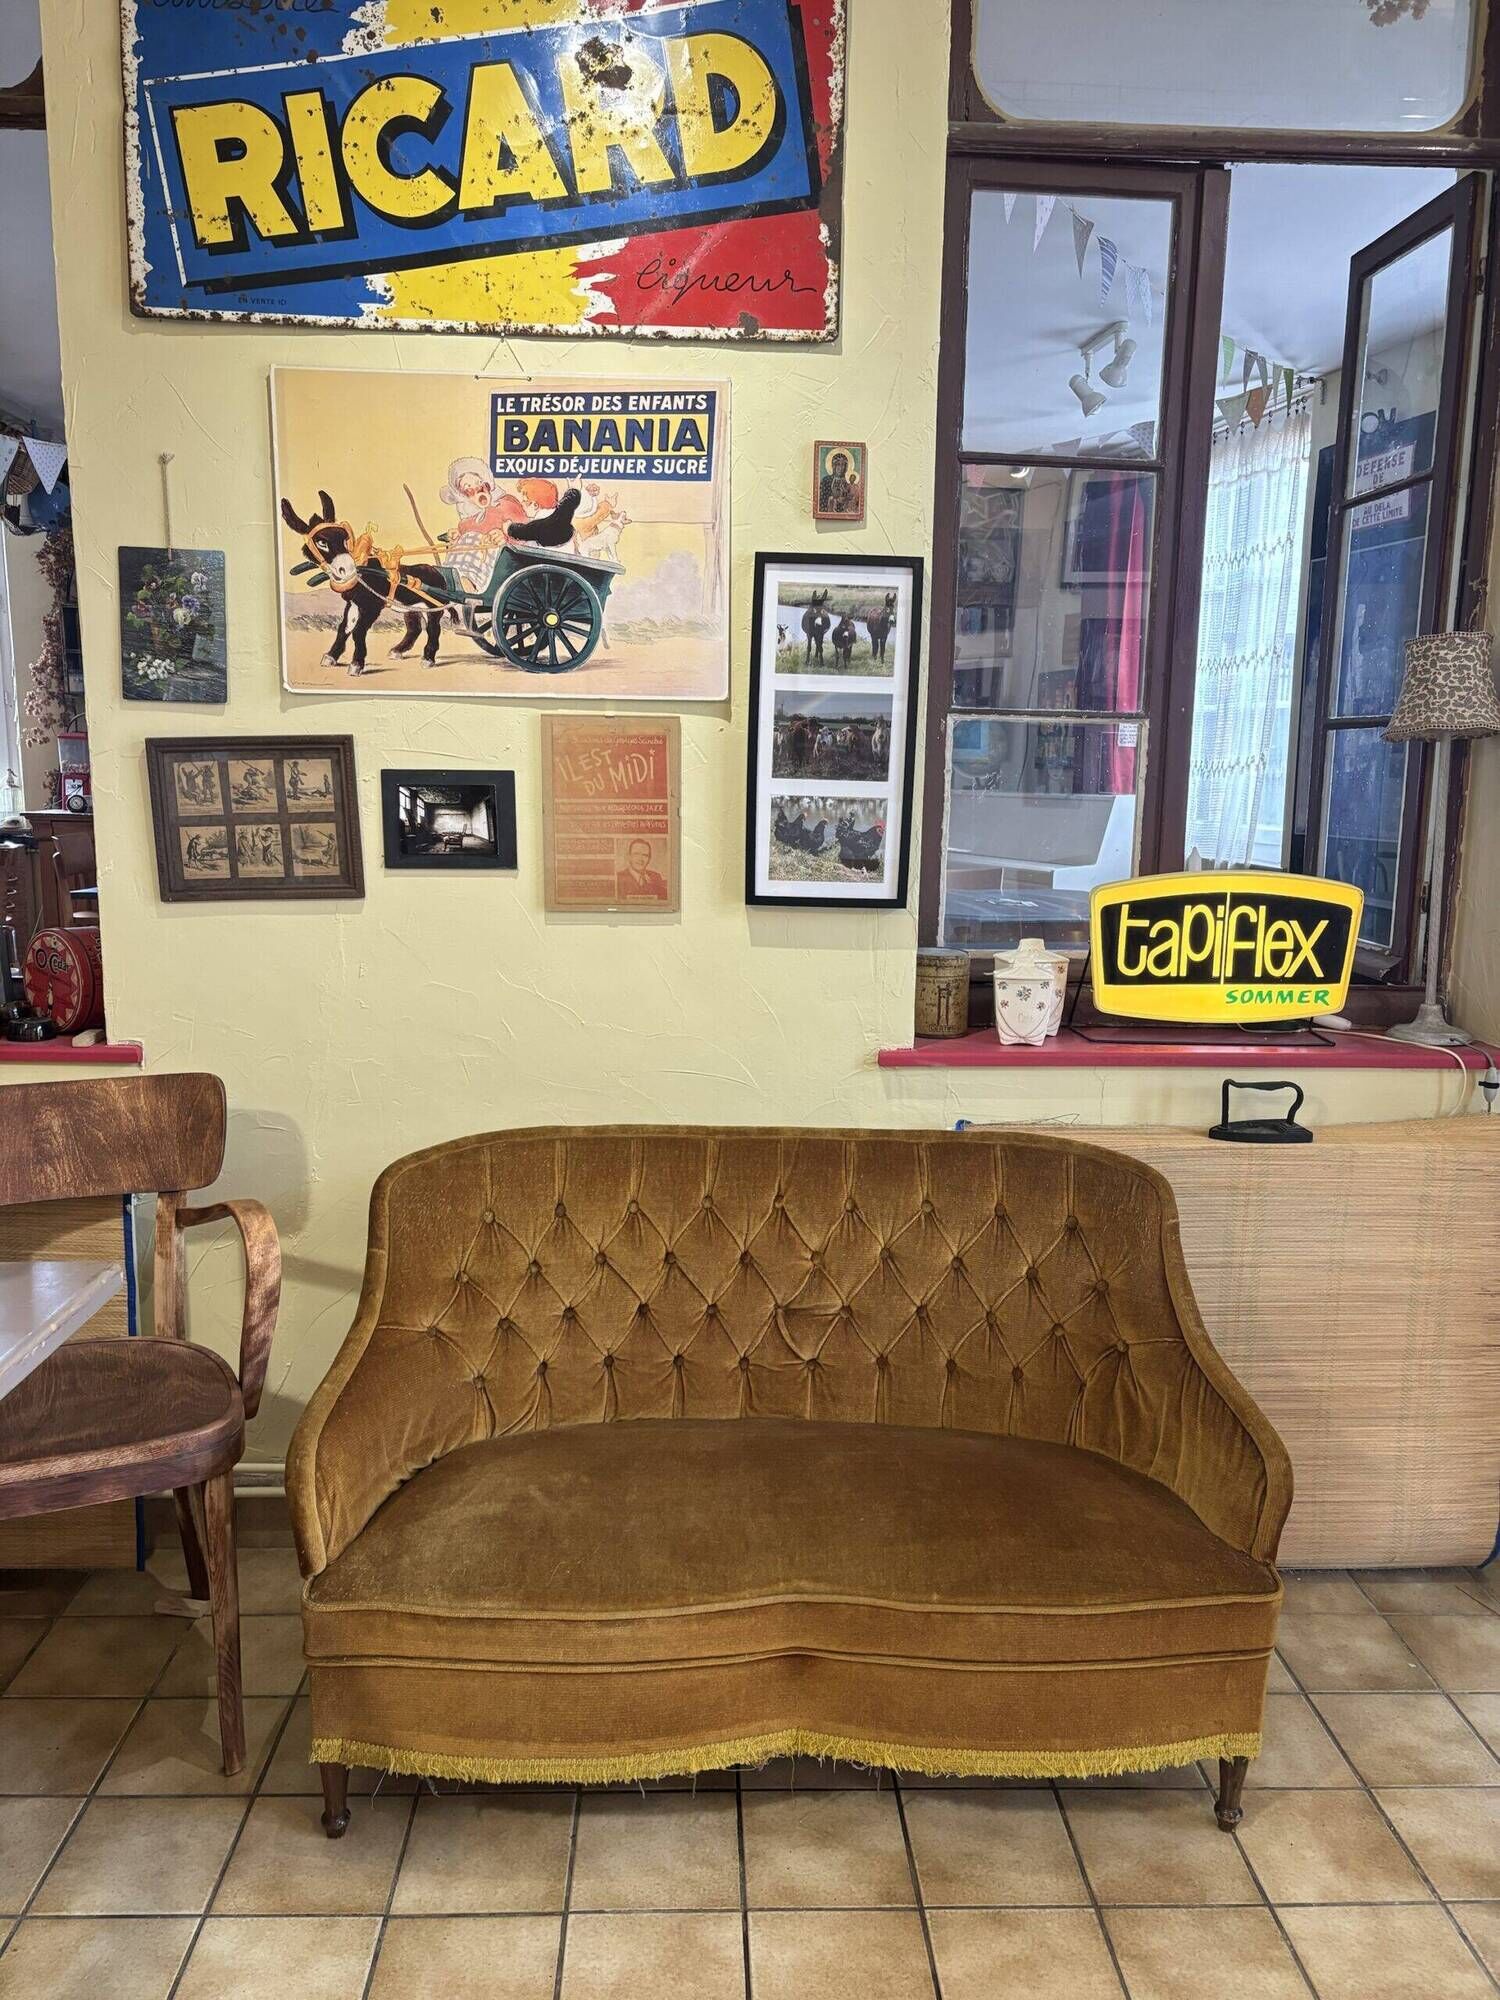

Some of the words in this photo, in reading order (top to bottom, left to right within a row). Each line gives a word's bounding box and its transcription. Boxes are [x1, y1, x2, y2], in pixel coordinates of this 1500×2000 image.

[172, 31, 784, 252] RICARD
[496, 397, 516, 413] LE
[520, 393, 585, 413] TRÉSOR
[591, 396, 623, 412] DES
[628, 394, 708, 411] ENFANTS
[503, 418, 706, 453] BANANIA
[495, 457, 555, 475] EXQUIS
[559, 456, 647, 474] DÉJEUNER
[651, 456, 708, 475] SUCRÉ
[578, 748, 612, 771] EST
[583, 773, 606, 796] DU
[1117, 903, 1330, 978] tapiflex
[1225, 989, 1330, 1006] SOMMER
